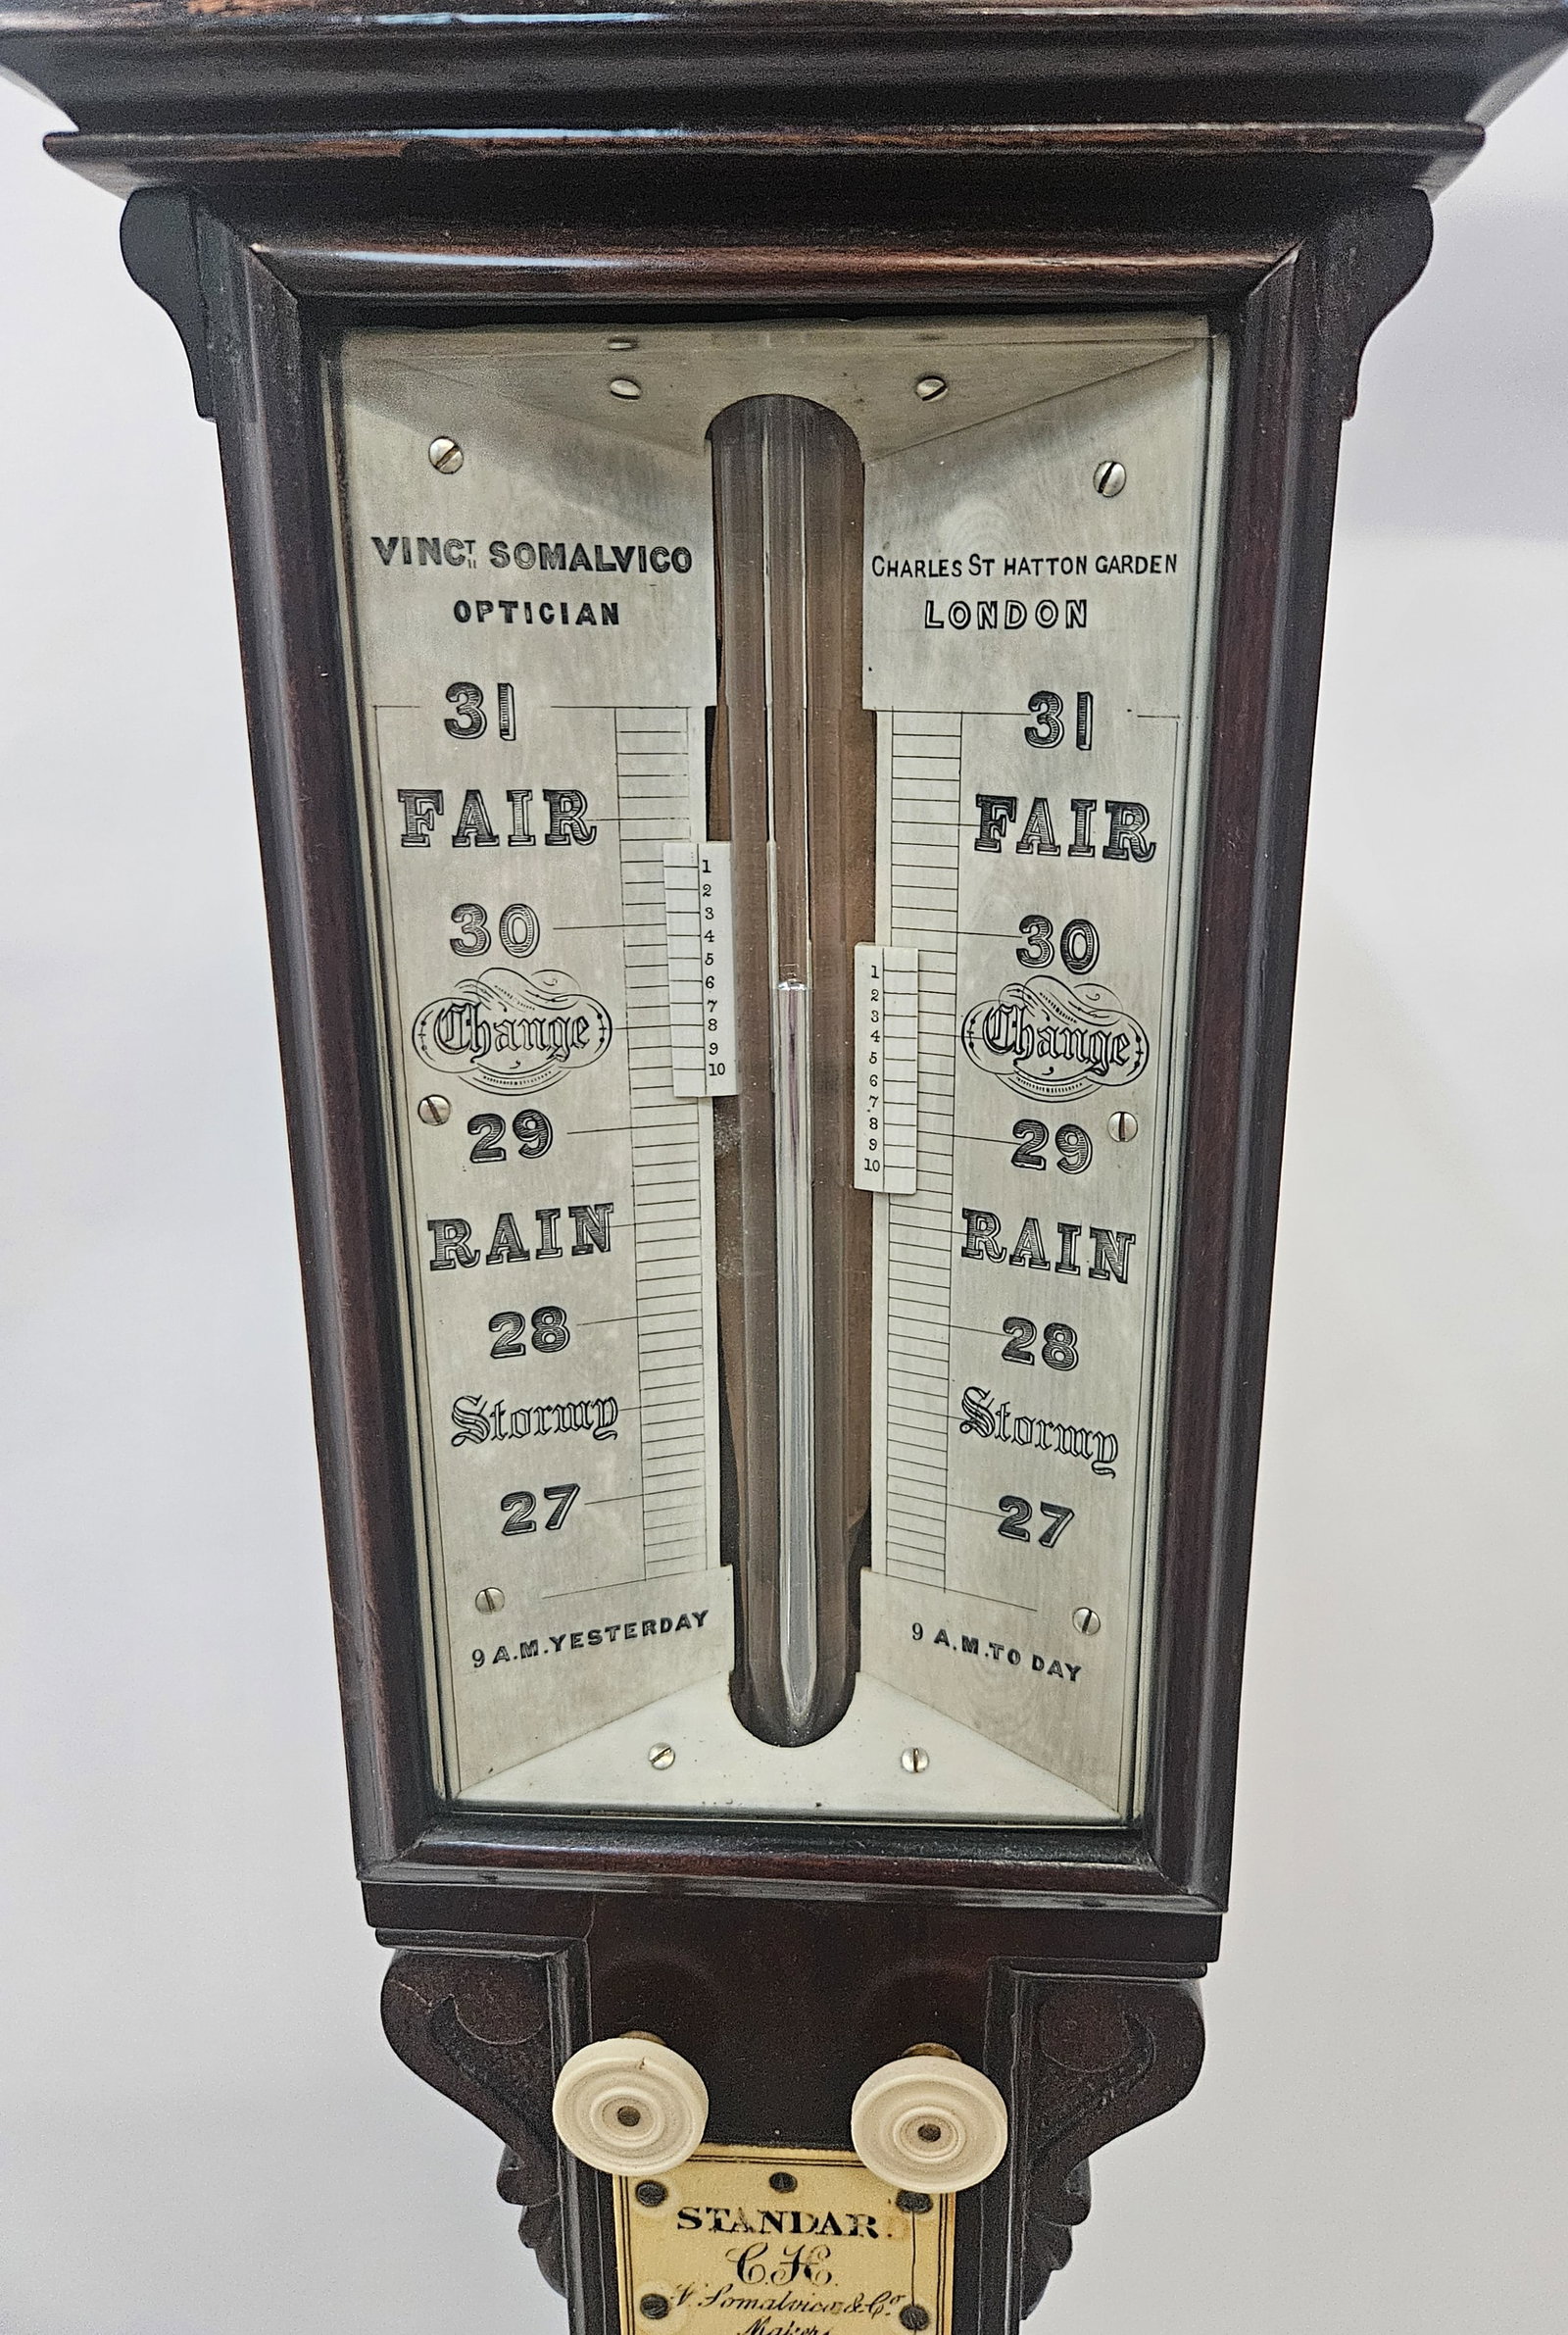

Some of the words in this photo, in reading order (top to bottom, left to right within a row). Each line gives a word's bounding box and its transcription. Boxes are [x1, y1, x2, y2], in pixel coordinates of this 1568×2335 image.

[489, 540, 693, 574] SOMALVICO
[871, 554, 962, 578] CHARLES
[1004, 555, 1088, 576] HATTON
[1095, 553, 1178, 574] GARDEN
[453, 599, 620, 626] OPTICIAN
[924, 598, 1088, 630] LONDON
[443, 680, 517, 742] 31
[1023, 689, 1095, 752] 31
[396, 788, 598, 848] FAIR
[973, 793, 1156, 863] FAIR
[702, 860, 712, 873] 1
[702, 884, 712, 898] 2
[705, 907, 714, 920] 3
[449, 902, 541, 959] 30
[704, 929, 715, 943] 4
[1015, 915, 1101, 975] 30
[705, 953, 714, 967] 5
[705, 975, 715, 989] 6
[870, 965, 880, 979] 1
[707, 999, 718, 1013] 7
[870, 989, 880, 1002] 2
[708, 1017, 718, 1032] 8
[870, 1010, 880, 1023] 3
[433, 1002, 591, 1064] Change
[870, 1029, 881, 1043] 4
[982, 1003, 1132, 1077] Change
[709, 1042, 719, 1056] 9
[868, 1051, 878, 1065] 5
[708, 1063, 726, 1077] 10
[869, 1074, 879, 1088] 6
[868, 1095, 879, 1109] 7
[869, 1117, 879, 1130] 8
[466, 1109, 554, 1164] 29
[868, 1138, 878, 1152] 9
[1010, 1118, 1094, 1175] 29
[863, 1158, 881, 1173] 10
[426, 1202, 614, 1272] RAIN
[960, 1207, 1137, 1284] RAIN
[488, 1305, 571, 1360] 28
[1001, 1316, 1079, 1372] 28
[451, 1394, 619, 1448] Stormy
[958, 1385, 1119, 1479] Stormy
[500, 1482, 581, 1536] 27
[998, 1494, 1075, 1549] 27
[911, 1621, 924, 1641] 9
[471, 1648, 486, 1668] 9
